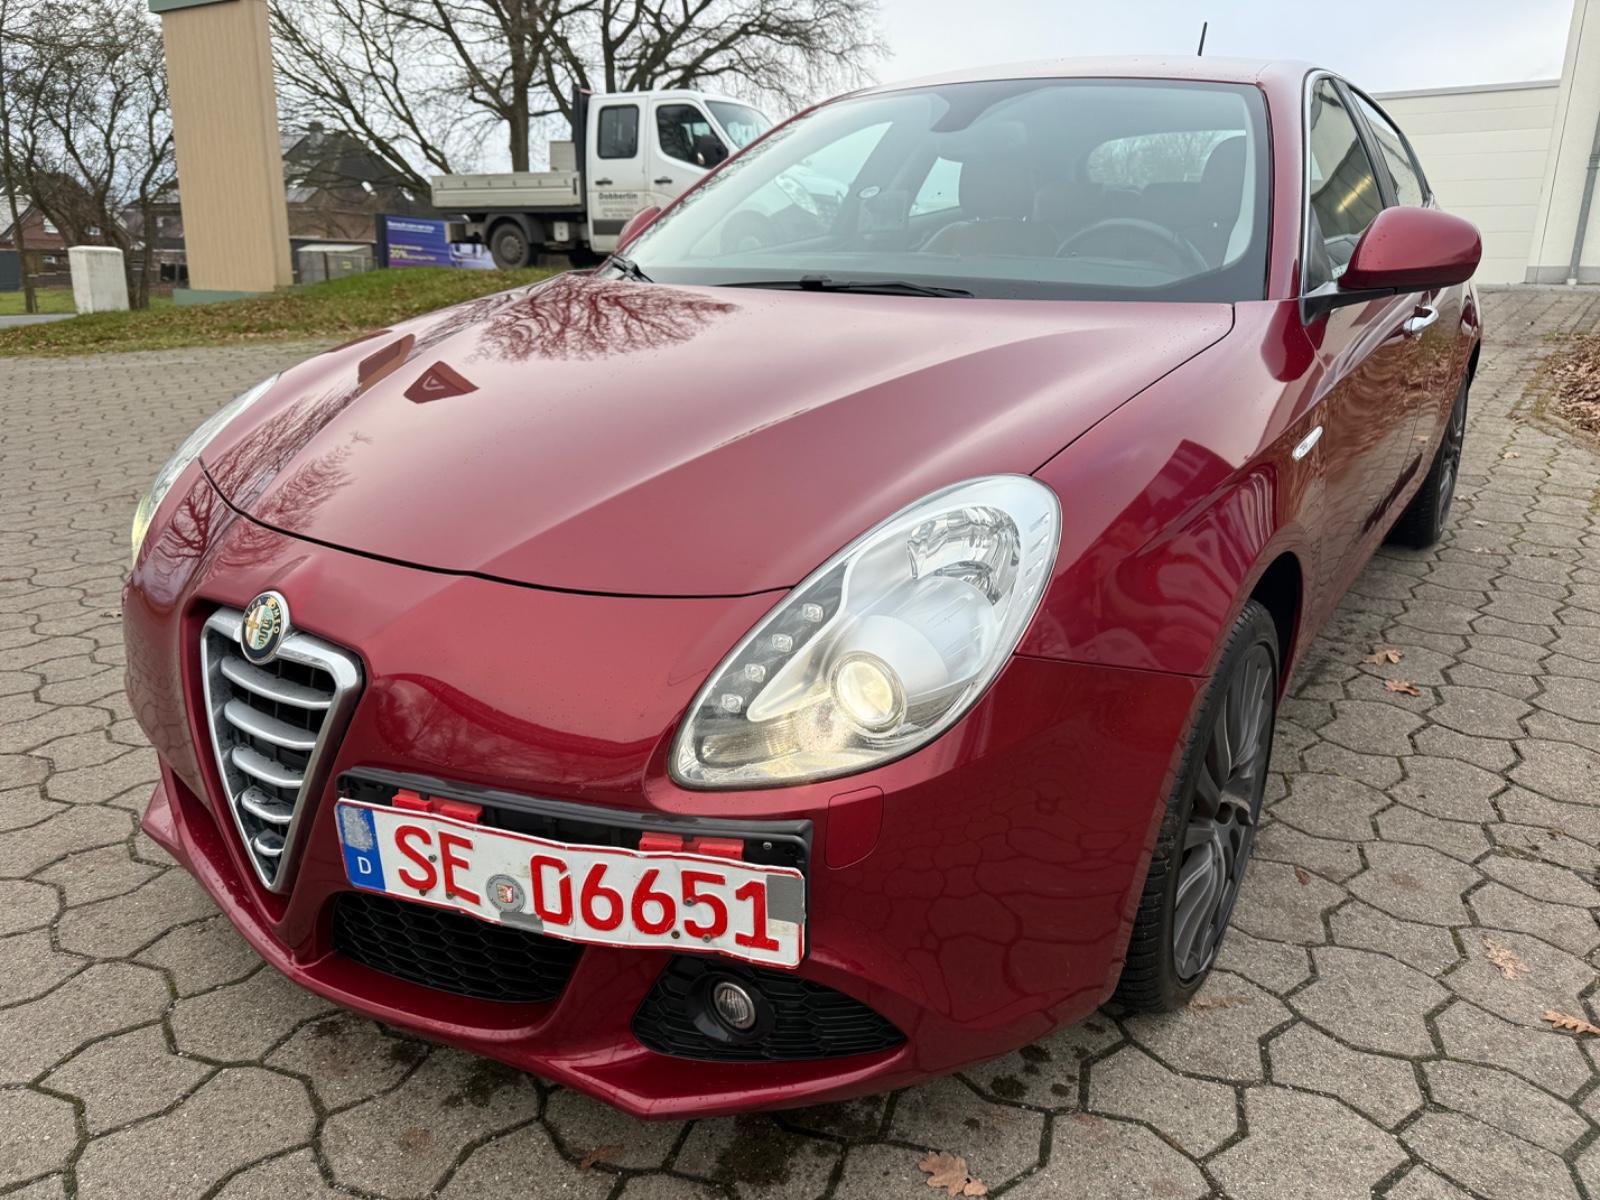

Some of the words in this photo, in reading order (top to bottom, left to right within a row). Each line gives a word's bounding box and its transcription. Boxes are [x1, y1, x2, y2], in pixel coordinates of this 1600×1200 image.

[266, 596, 281, 634] ROMEO
[357, 856, 372, 874] D
[394, 825, 481, 906] SE
[530, 854, 780, 952] 06651
